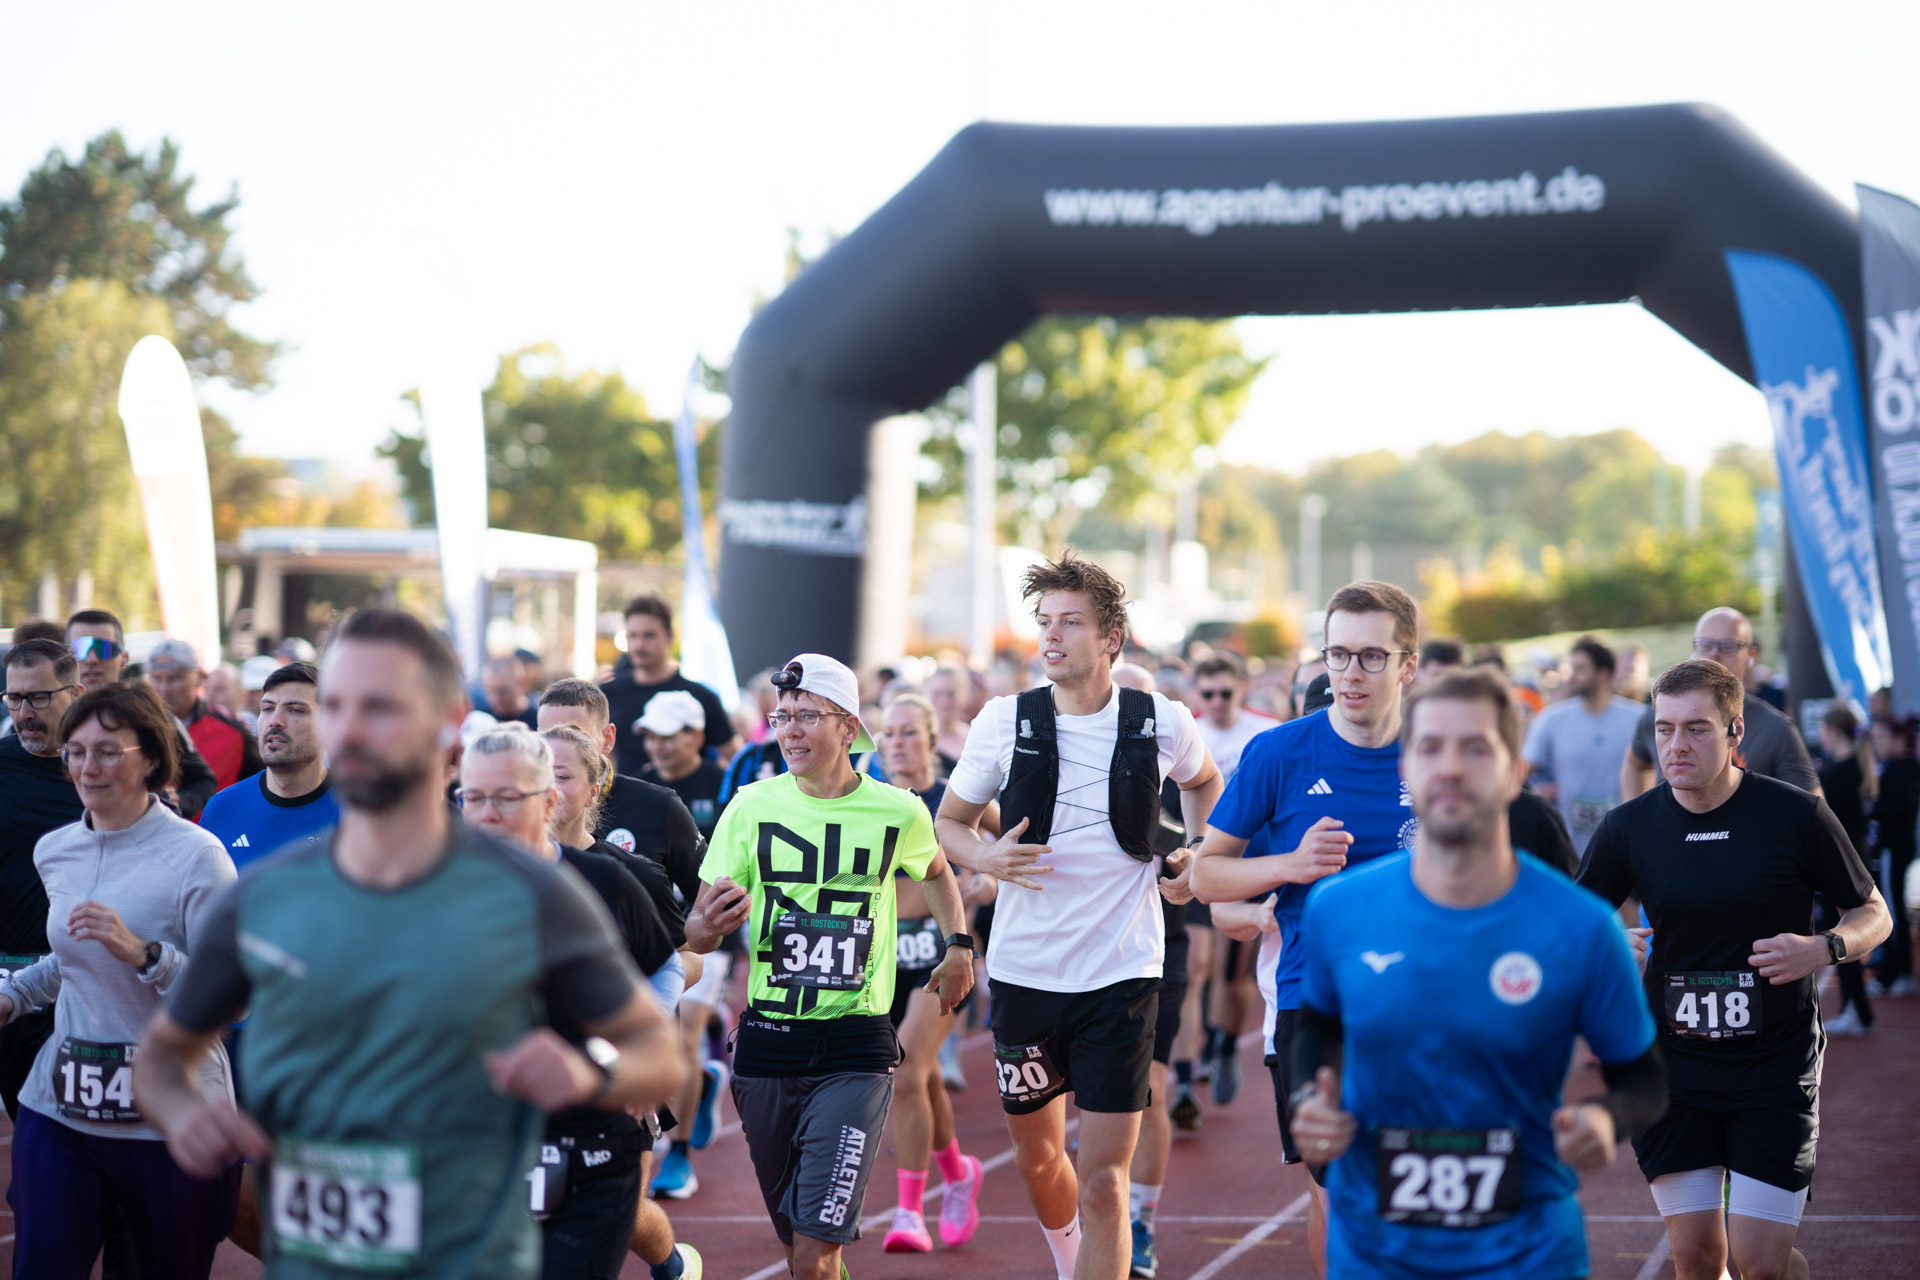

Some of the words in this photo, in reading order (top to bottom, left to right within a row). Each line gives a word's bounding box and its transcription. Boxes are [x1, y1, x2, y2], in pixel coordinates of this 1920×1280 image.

[1045, 167, 1604, 235] www.agentur-proevent.de
[1397, 816, 1421, 838] ROSTOC
[1685, 830, 1730, 842] HUMMEL
[782, 933, 856, 976] 341
[897, 931, 938, 962] 08
[1675, 991, 1751, 1028] 418
[61, 1060, 135, 1109] 154
[832, 1126, 866, 1205] ATHLETIC
[1389, 1152, 1506, 1213] 287
[286, 1178, 390, 1243] 493
[819, 1200, 848, 1227] 28
